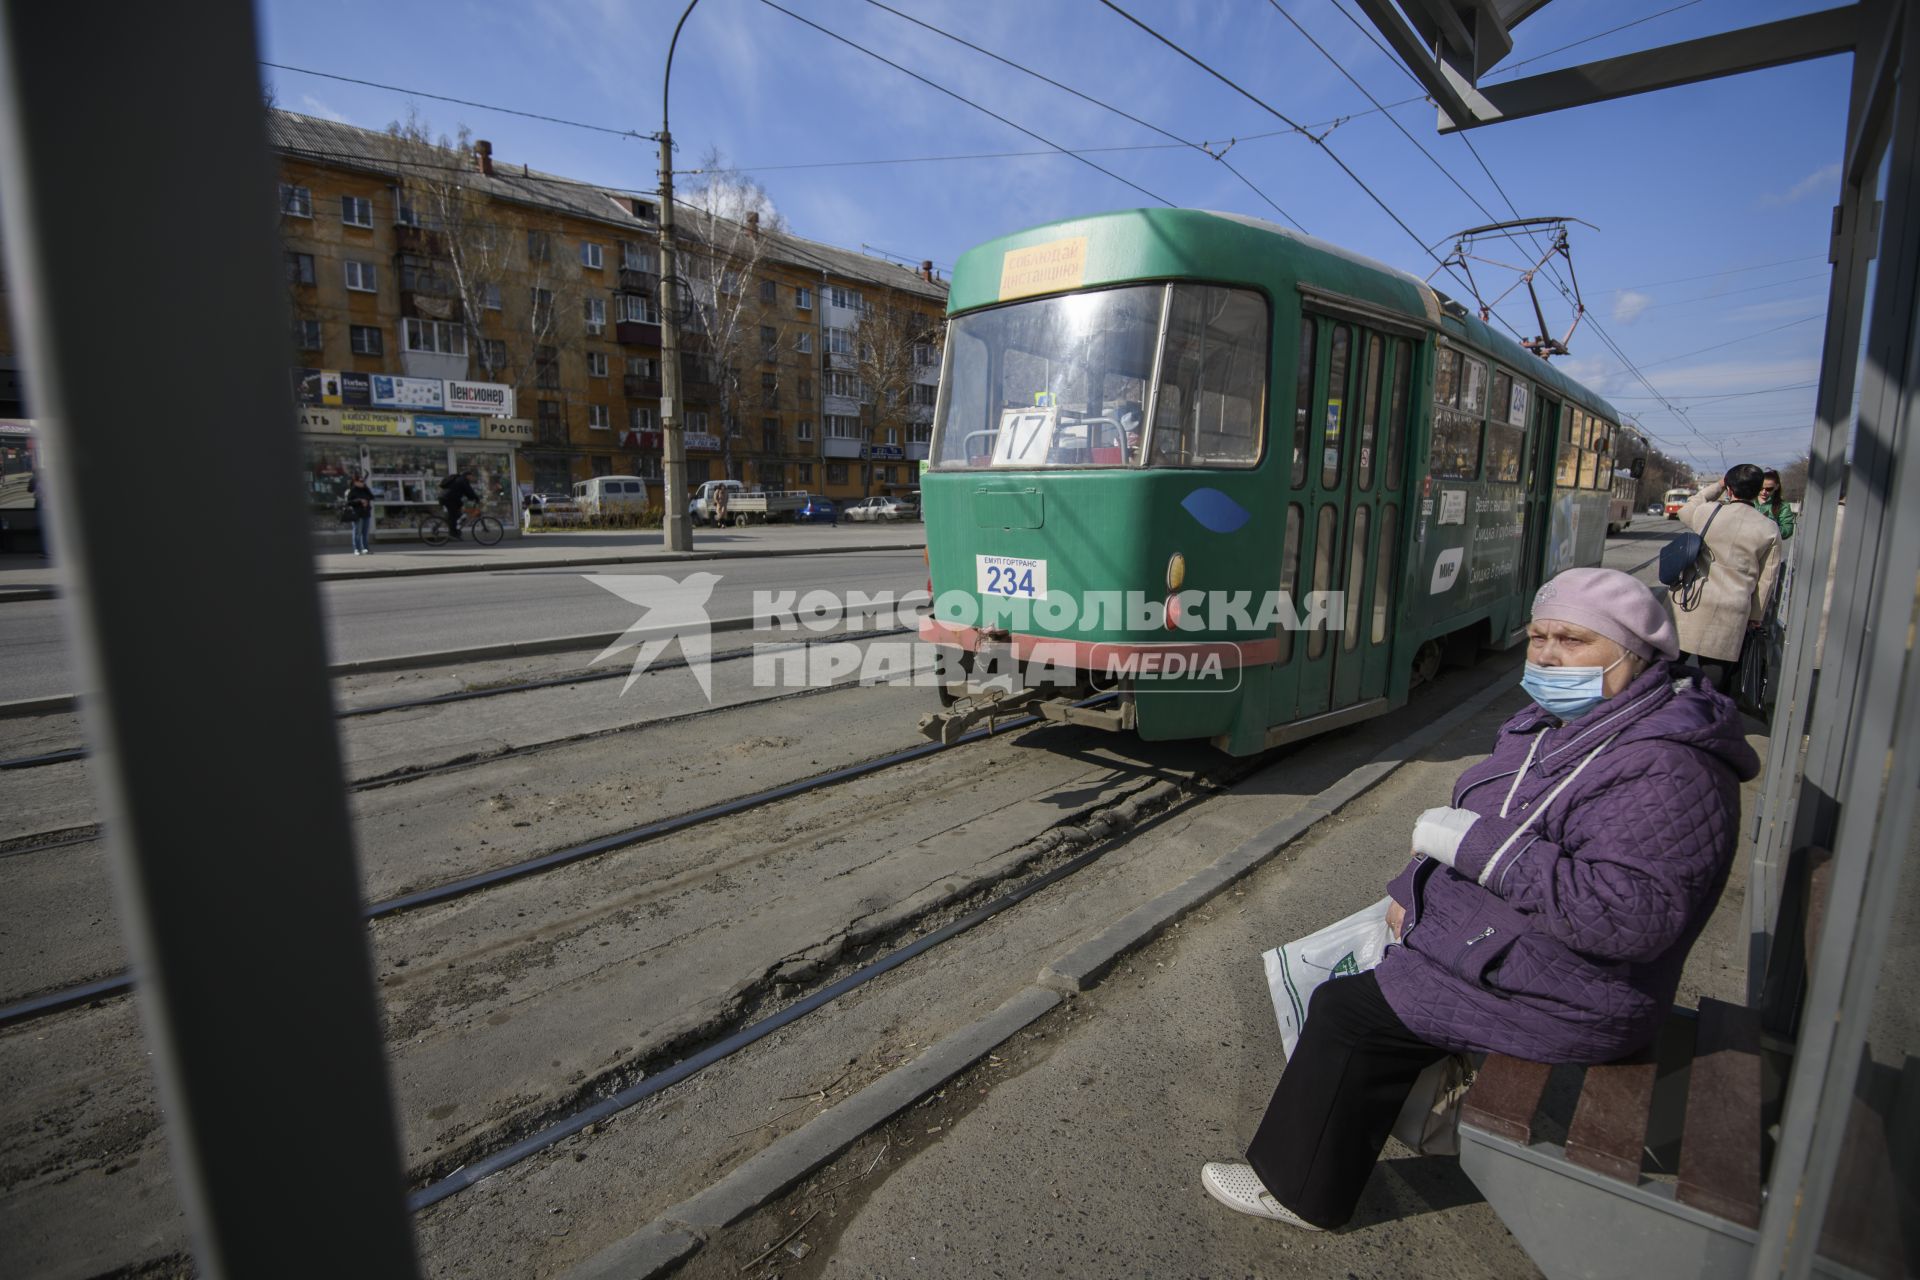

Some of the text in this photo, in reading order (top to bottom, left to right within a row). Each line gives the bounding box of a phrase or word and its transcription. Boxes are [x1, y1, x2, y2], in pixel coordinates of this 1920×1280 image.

[450, 382, 504, 405] Пенсионер
[301, 415, 330, 426] АТЬ
[1007, 416, 1045, 459] 17
[984, 557, 1037, 568] ЕМУП ГОРТРАНС
[1439, 562, 1455, 578] МИР
[987, 566, 1035, 597] 234
